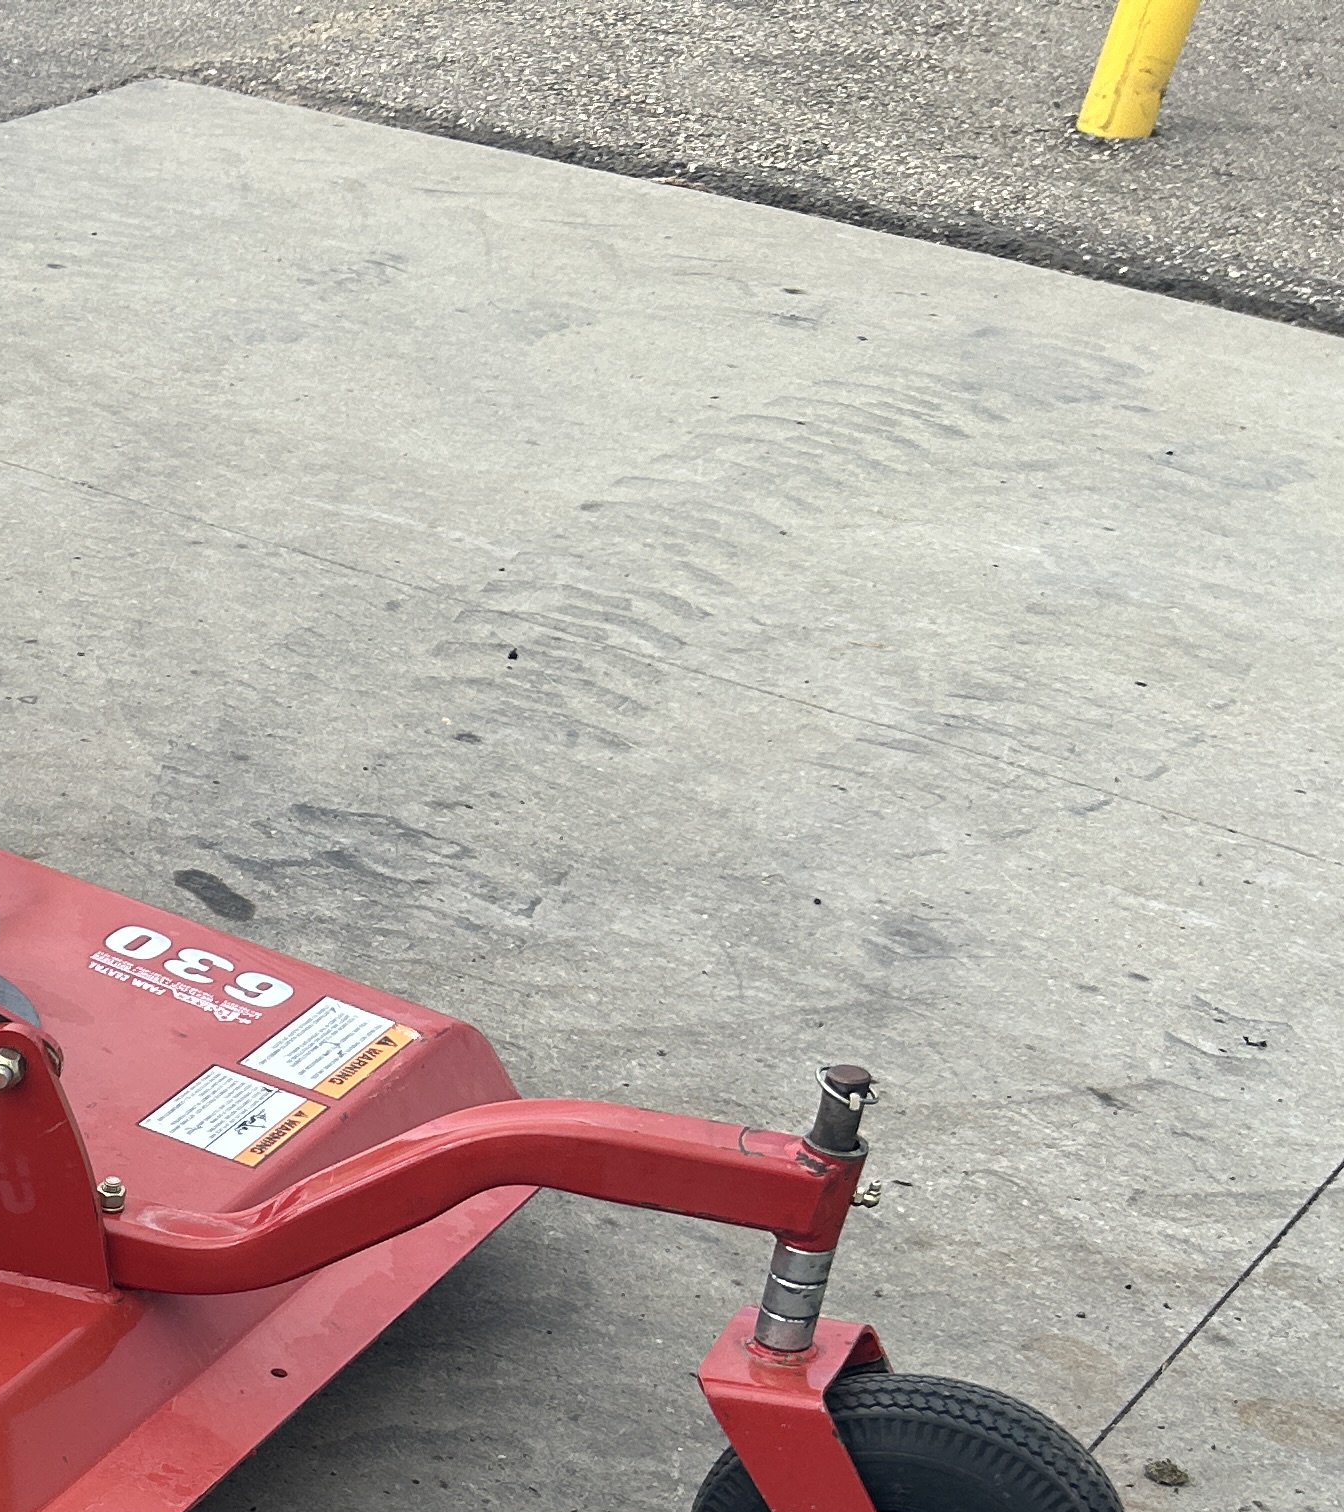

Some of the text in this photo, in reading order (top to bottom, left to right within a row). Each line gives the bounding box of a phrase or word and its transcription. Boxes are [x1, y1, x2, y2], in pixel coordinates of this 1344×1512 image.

[104, 924, 295, 1009] 630
[328, 1045, 383, 1085] WARNING
[249, 1118, 300, 1155] WARNING
